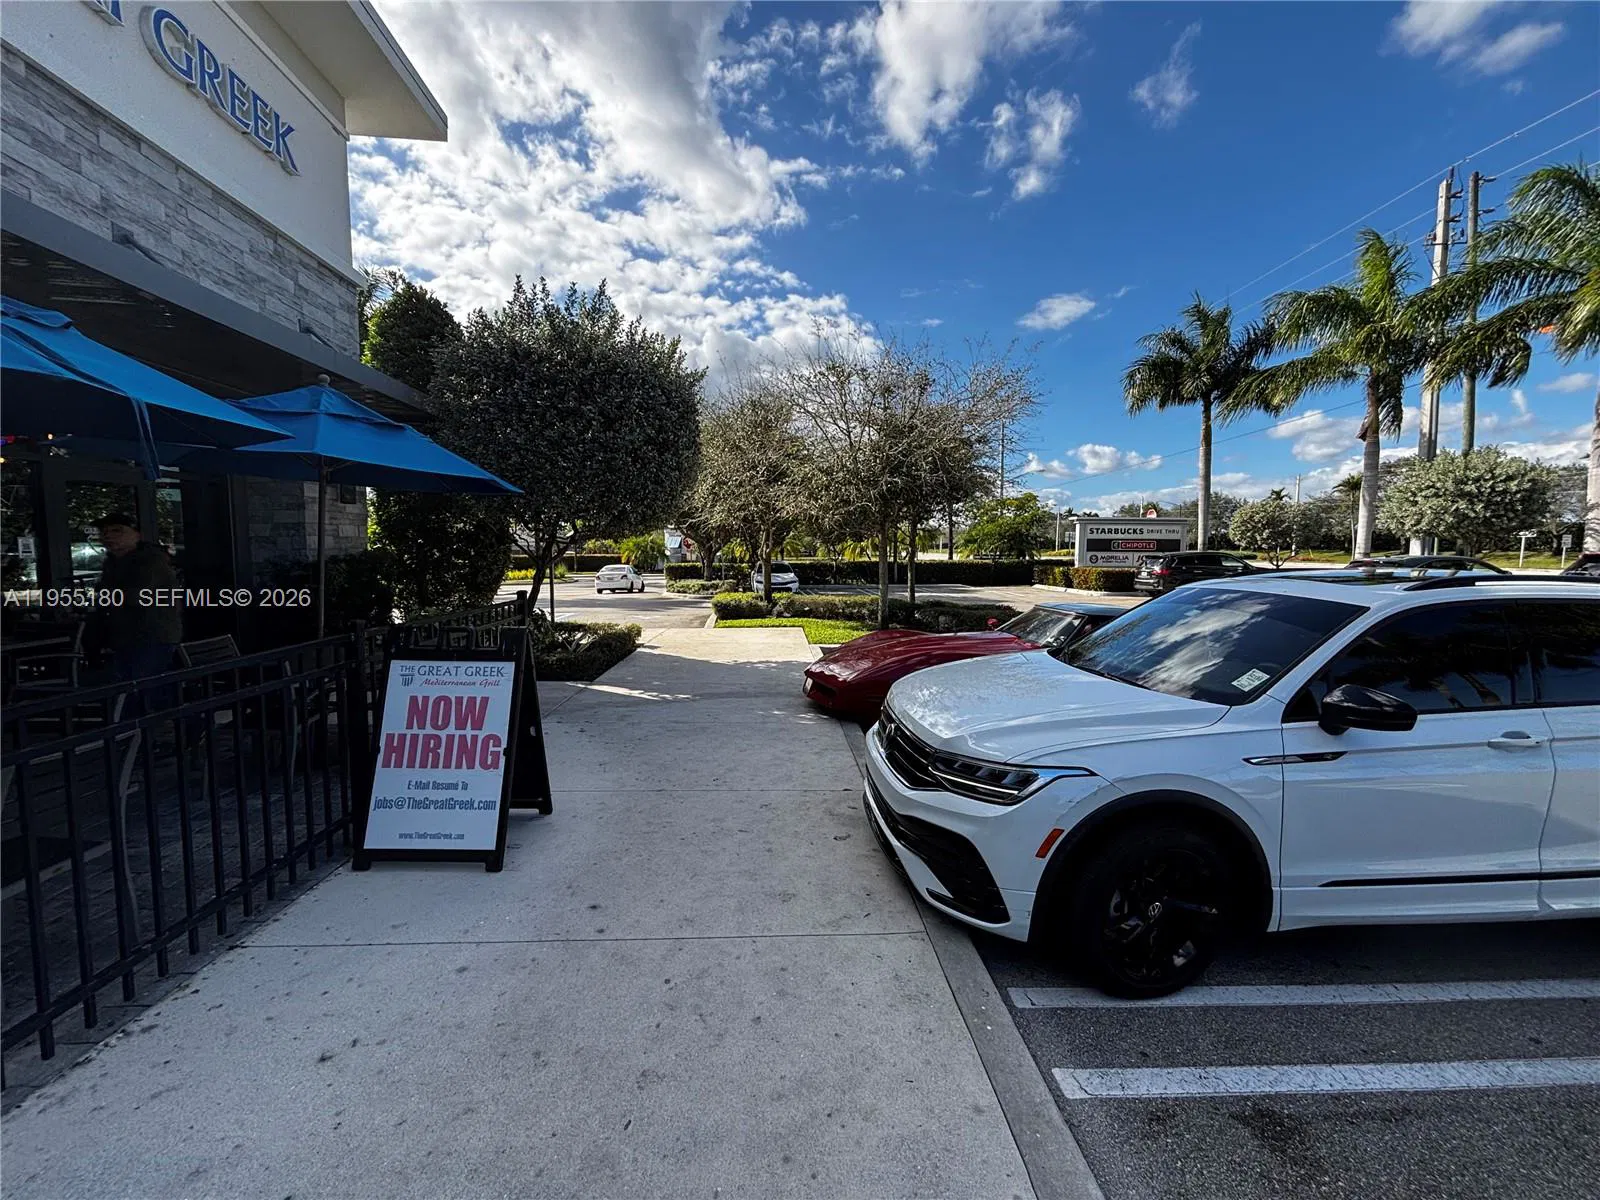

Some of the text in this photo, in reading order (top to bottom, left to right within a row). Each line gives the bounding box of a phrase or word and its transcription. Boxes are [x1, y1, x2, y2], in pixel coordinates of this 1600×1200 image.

[149, 7, 300, 176] GREEK
[1089, 527, 1144, 535] STARBUCKS
[400, 665, 505, 678] THE GREAT GREEK
[420, 678, 501, 688] Mediterranean Grill
[405, 695, 490, 731] NOW
[381, 732, 502, 770] HIRING
[407, 780, 431, 790] E-Mail
[461, 780, 469, 791] To
[372, 796, 497, 811] jobs@TheGreatGreek.com
